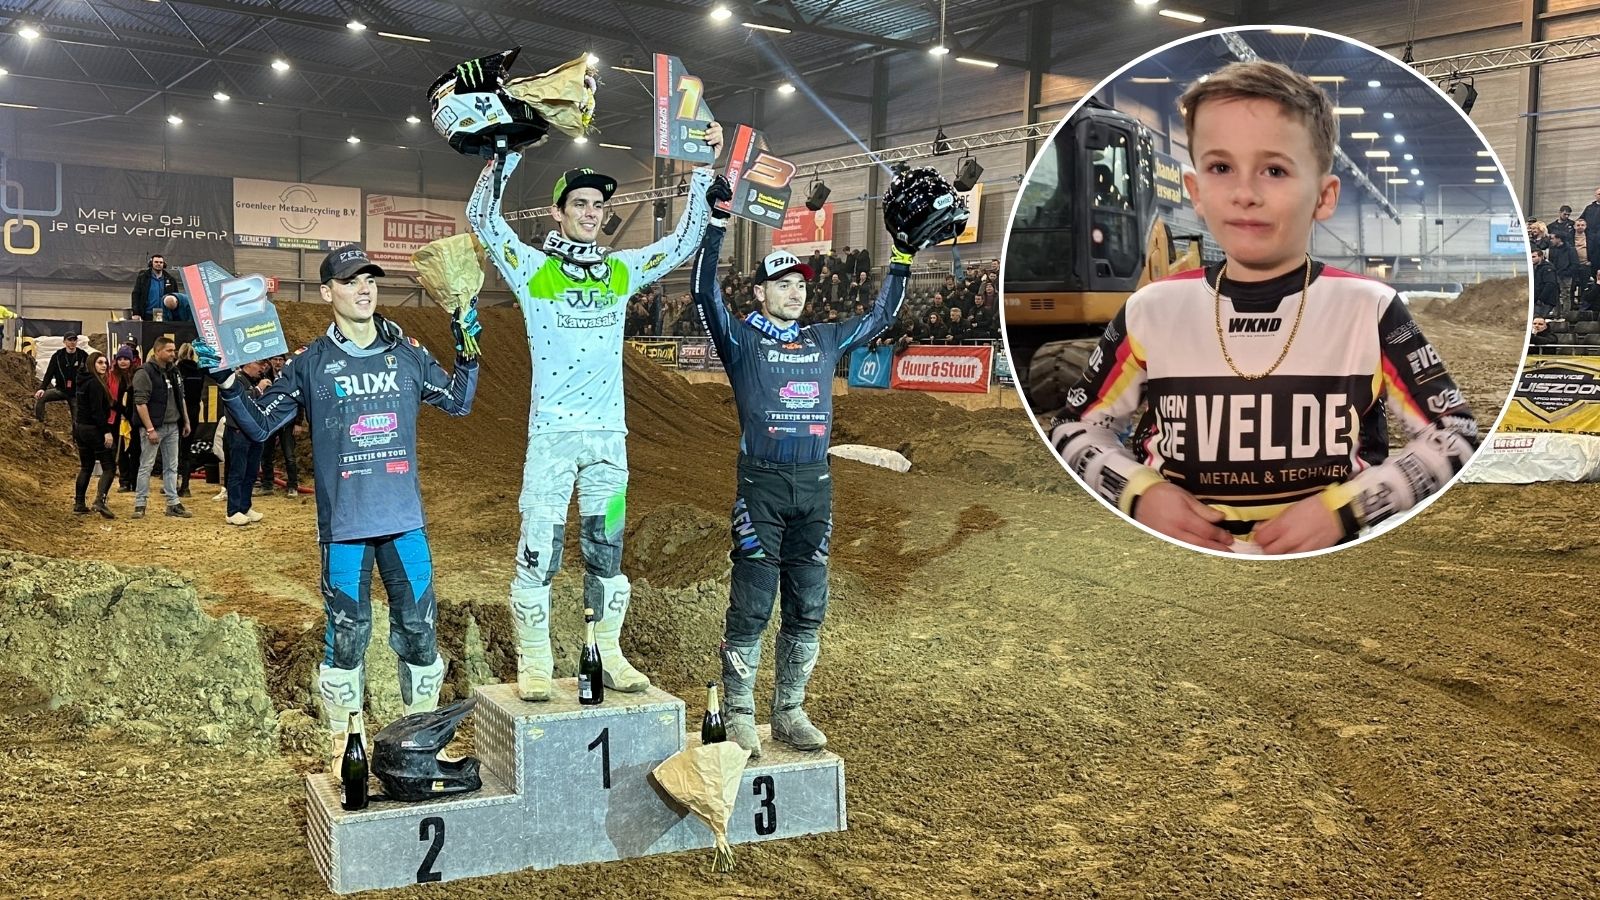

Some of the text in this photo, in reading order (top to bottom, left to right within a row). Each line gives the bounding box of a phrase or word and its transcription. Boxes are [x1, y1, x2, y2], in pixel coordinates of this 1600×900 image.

[677, 74, 704, 120] 1
[742, 152, 796, 188] 3
[78, 207, 200, 228] Met wie ga jij
[235, 201, 277, 212] Groenleer
[278, 203, 341, 218] Metaalrecycling
[50, 220, 228, 241] je geld verdienen?
[239, 234, 272, 244] ZIERIKZEE
[218, 273, 268, 324] 2
[1228, 317, 1283, 334] WKND
[779, 352, 820, 363] KENNY
[902, 361, 978, 379] Huur&Stuur
[334, 371, 400, 397] BLIXX
[771, 413, 800, 421] FRIETJE
[1159, 395, 1188, 419] VAN
[1195, 393, 1349, 462] VELDE
[1159, 421, 1186, 462] DE
[343, 453, 376, 463] FRIETJE
[1199, 465, 1350, 485] METAAL & TECHNIEK
[733, 497, 766, 559] KENNY
[587, 727, 611, 790] 1
[752, 775, 777, 837] 3
[416, 816, 446, 884] 2
